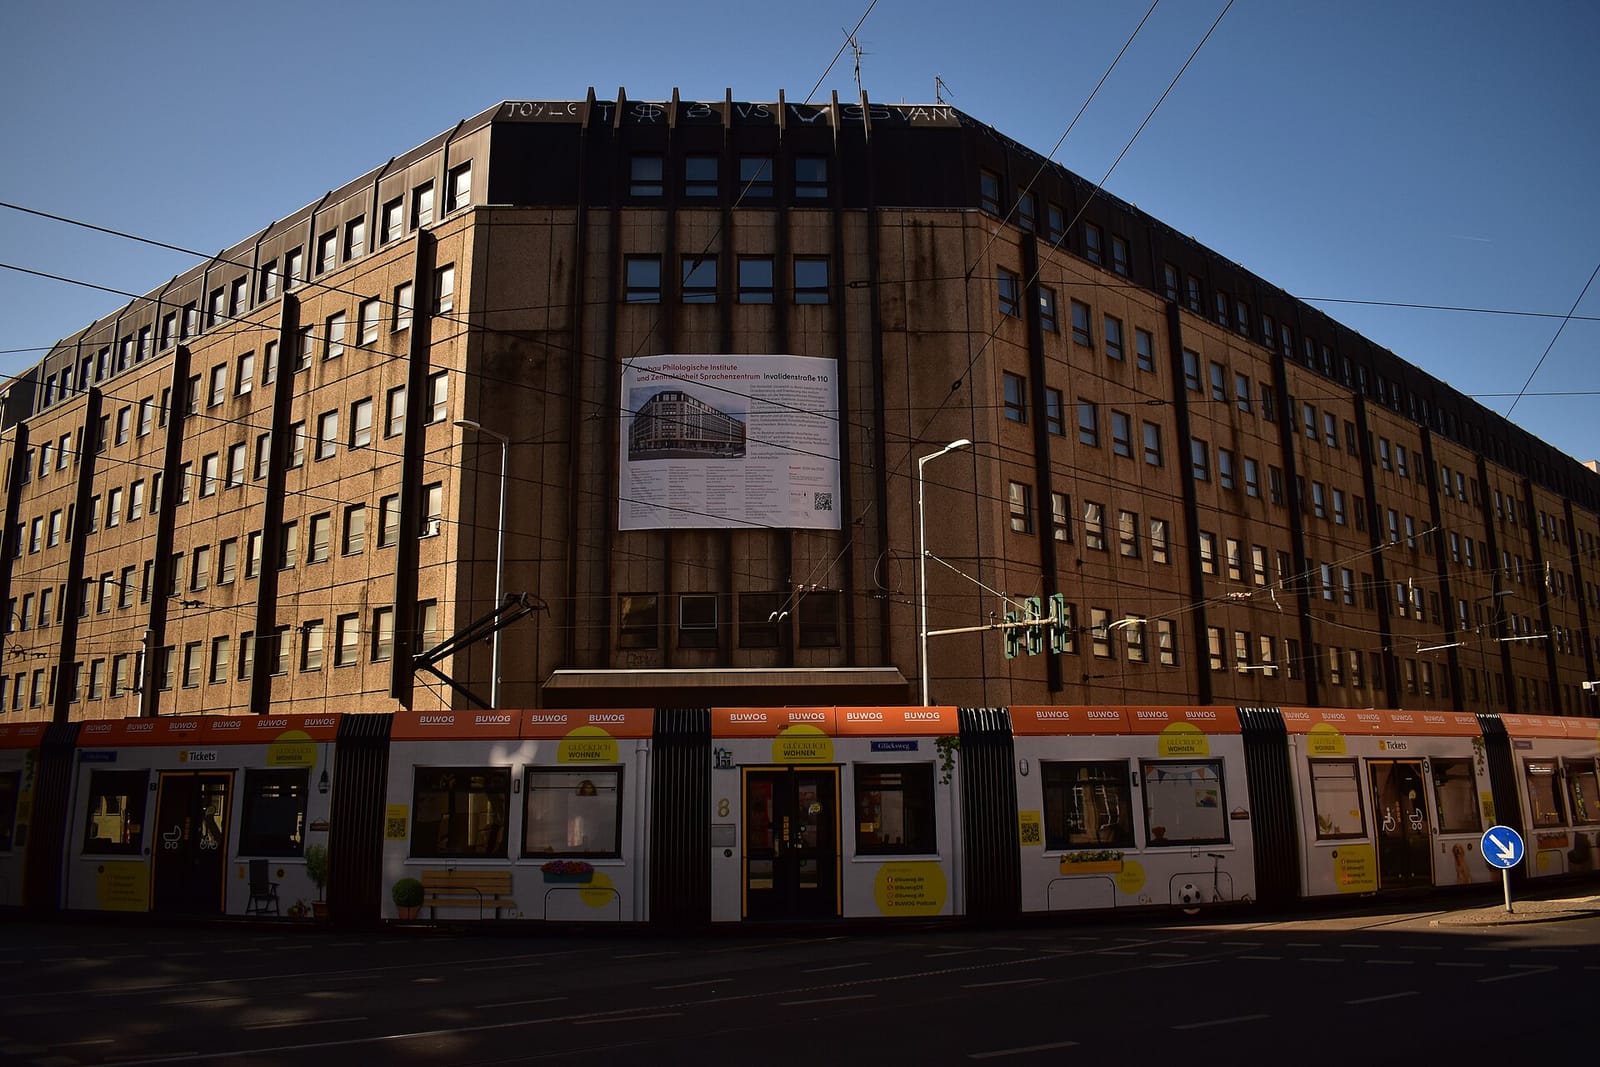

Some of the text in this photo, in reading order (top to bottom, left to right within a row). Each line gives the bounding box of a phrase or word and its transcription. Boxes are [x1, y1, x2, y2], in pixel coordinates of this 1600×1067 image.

[662, 363, 708, 372] Philologische
[710, 363, 738, 371] Institute
[637, 374, 649, 382] und
[700, 372, 761, 381] Sprachenzentrum
[763, 372, 816, 382] Invalidenstraße
[817, 375, 829, 383] 110
[419, 715, 455, 723] BUWOG
[475, 714, 511, 723] BUWOG
[532, 714, 568, 722] BUWOG
[588, 713, 625, 722] BUWOG
[730, 713, 767, 721] BUWOG
[788, 712, 825, 720] BUWOG
[846, 712, 883, 720] BUWOG
[904, 711, 941, 720] BUWOG
[169, 721, 198, 729] BUWOG
[212, 720, 241, 729] BUWOG
[257, 719, 287, 727] BUWOG
[304, 718, 335, 726] BUWOG
[1386, 741, 1408, 751] Tickets
[190, 752, 216, 761] Tickets
[783, 749, 816, 757] WOHNEN
[1423, 760, 1430, 774] 9
[717, 798, 730, 818] 8
